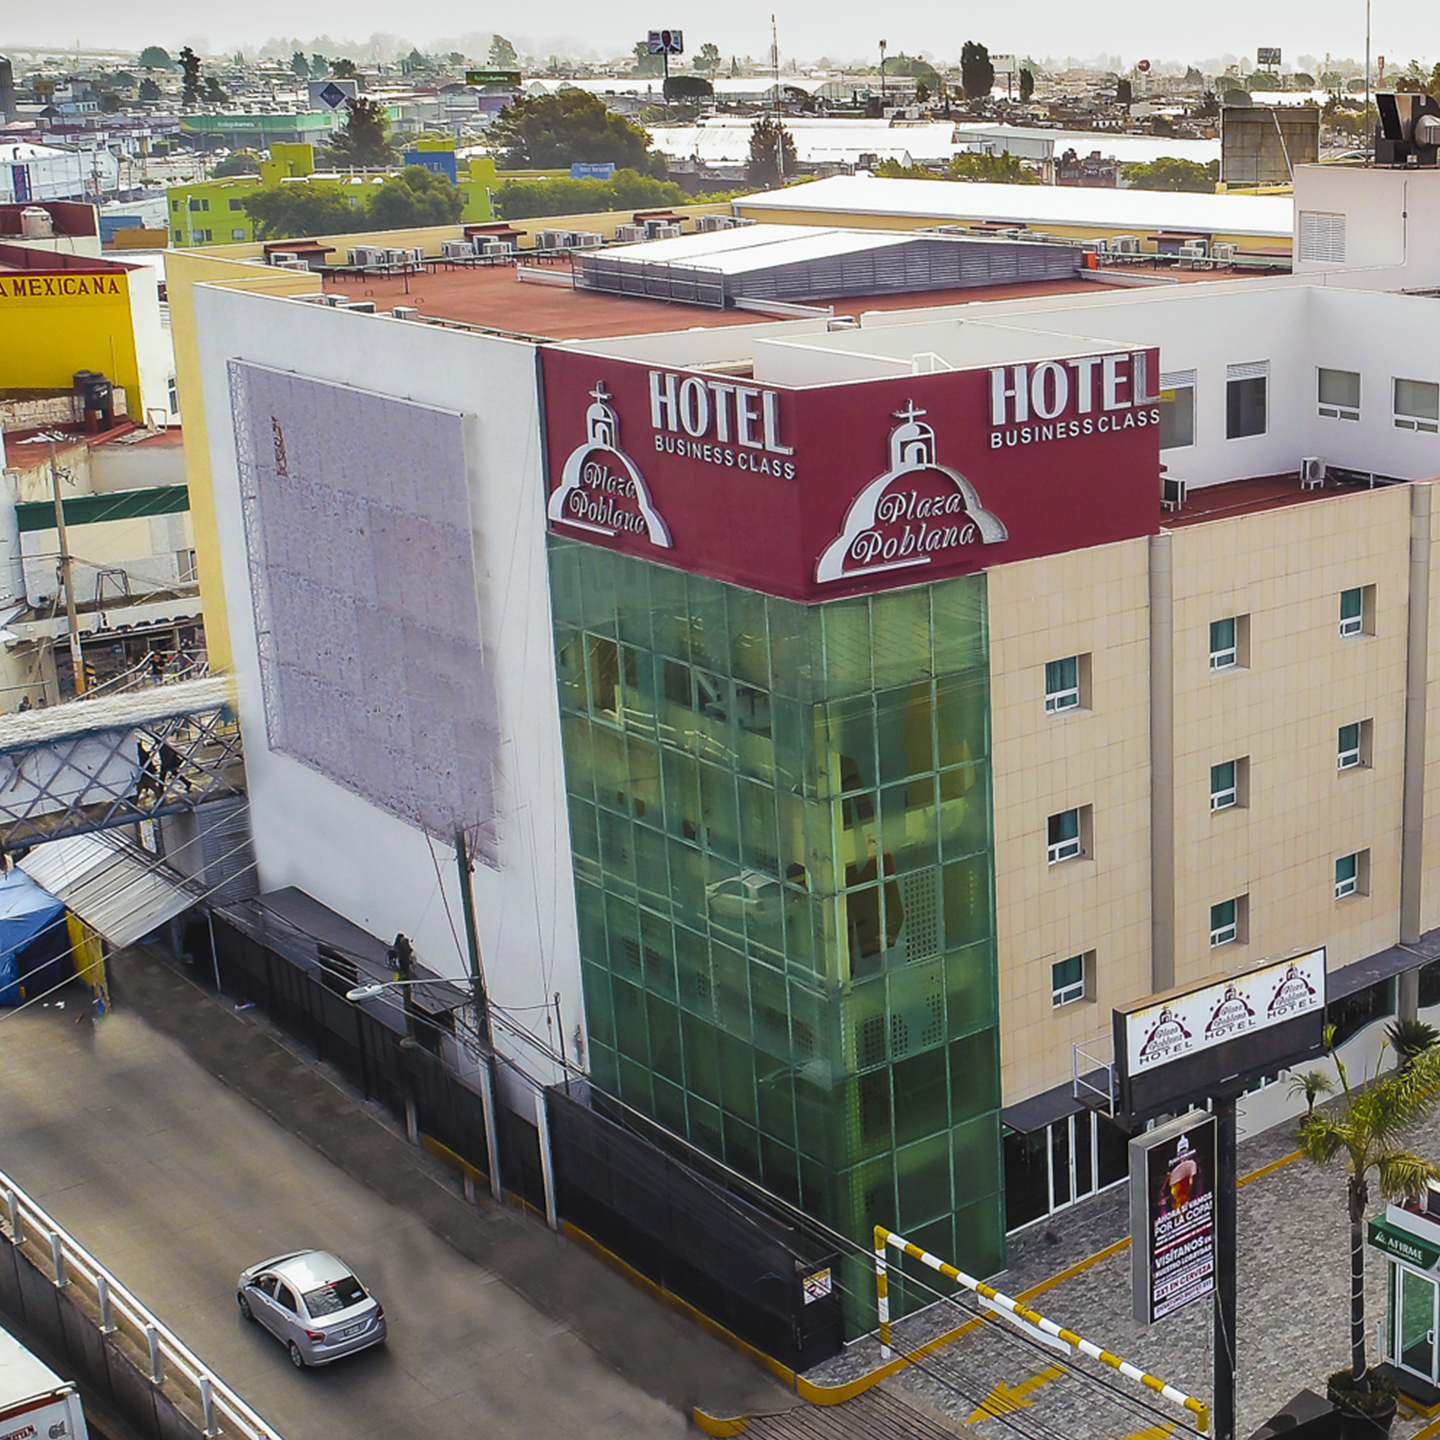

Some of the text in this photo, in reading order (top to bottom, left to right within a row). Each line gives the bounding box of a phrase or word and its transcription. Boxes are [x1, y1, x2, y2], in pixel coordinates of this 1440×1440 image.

[12, 276, 120, 296] MEXICANA
[988, 351, 1161, 426] HOTEL
[649, 370, 795, 456] HOTEL
[991, 408, 1161, 449] BUSINESS CLASS
[655, 435, 796, 480] BUSINESS CLASS
[583, 461, 638, 499] Plaza
[569, 489, 648, 535] Poblana
[878, 490, 962, 524] Plaza
[851, 522, 975, 564] Poblana
[1267, 997, 1317, 1019] HOTEL
[1205, 1019, 1256, 1041] HOTEL
[1140, 1041, 1192, 1065] HOTEL
[1174, 1214, 1185, 1228] LA
[1388, 1238, 1422, 1260] AFIRME
[1170, 1281, 1179, 1291] EN
[1180, 1264, 1211, 1285] CERVEZA
